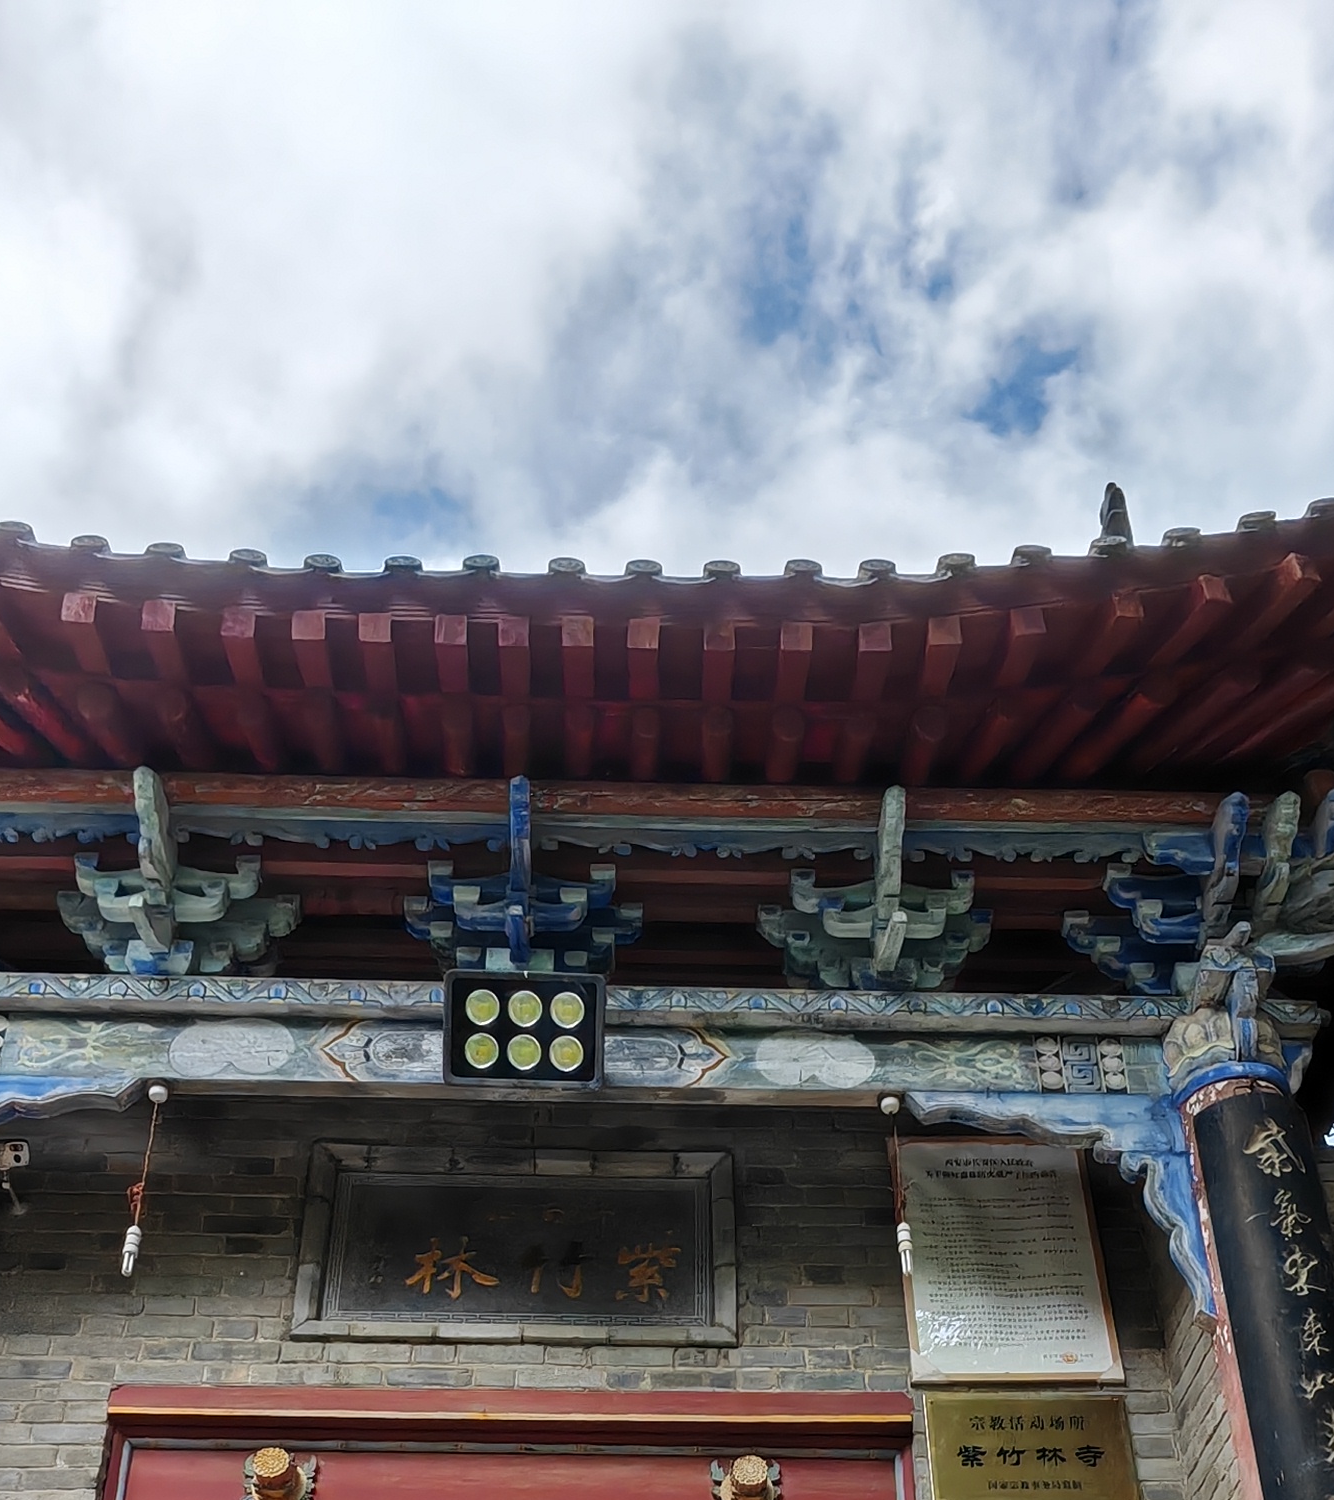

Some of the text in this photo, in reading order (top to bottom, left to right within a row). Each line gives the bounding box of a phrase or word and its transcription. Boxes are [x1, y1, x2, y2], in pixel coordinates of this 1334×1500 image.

[968, 1415, 1085, 1431] 宗教活动场所
[957, 1445, 1105, 1468] 紫竹林寺
